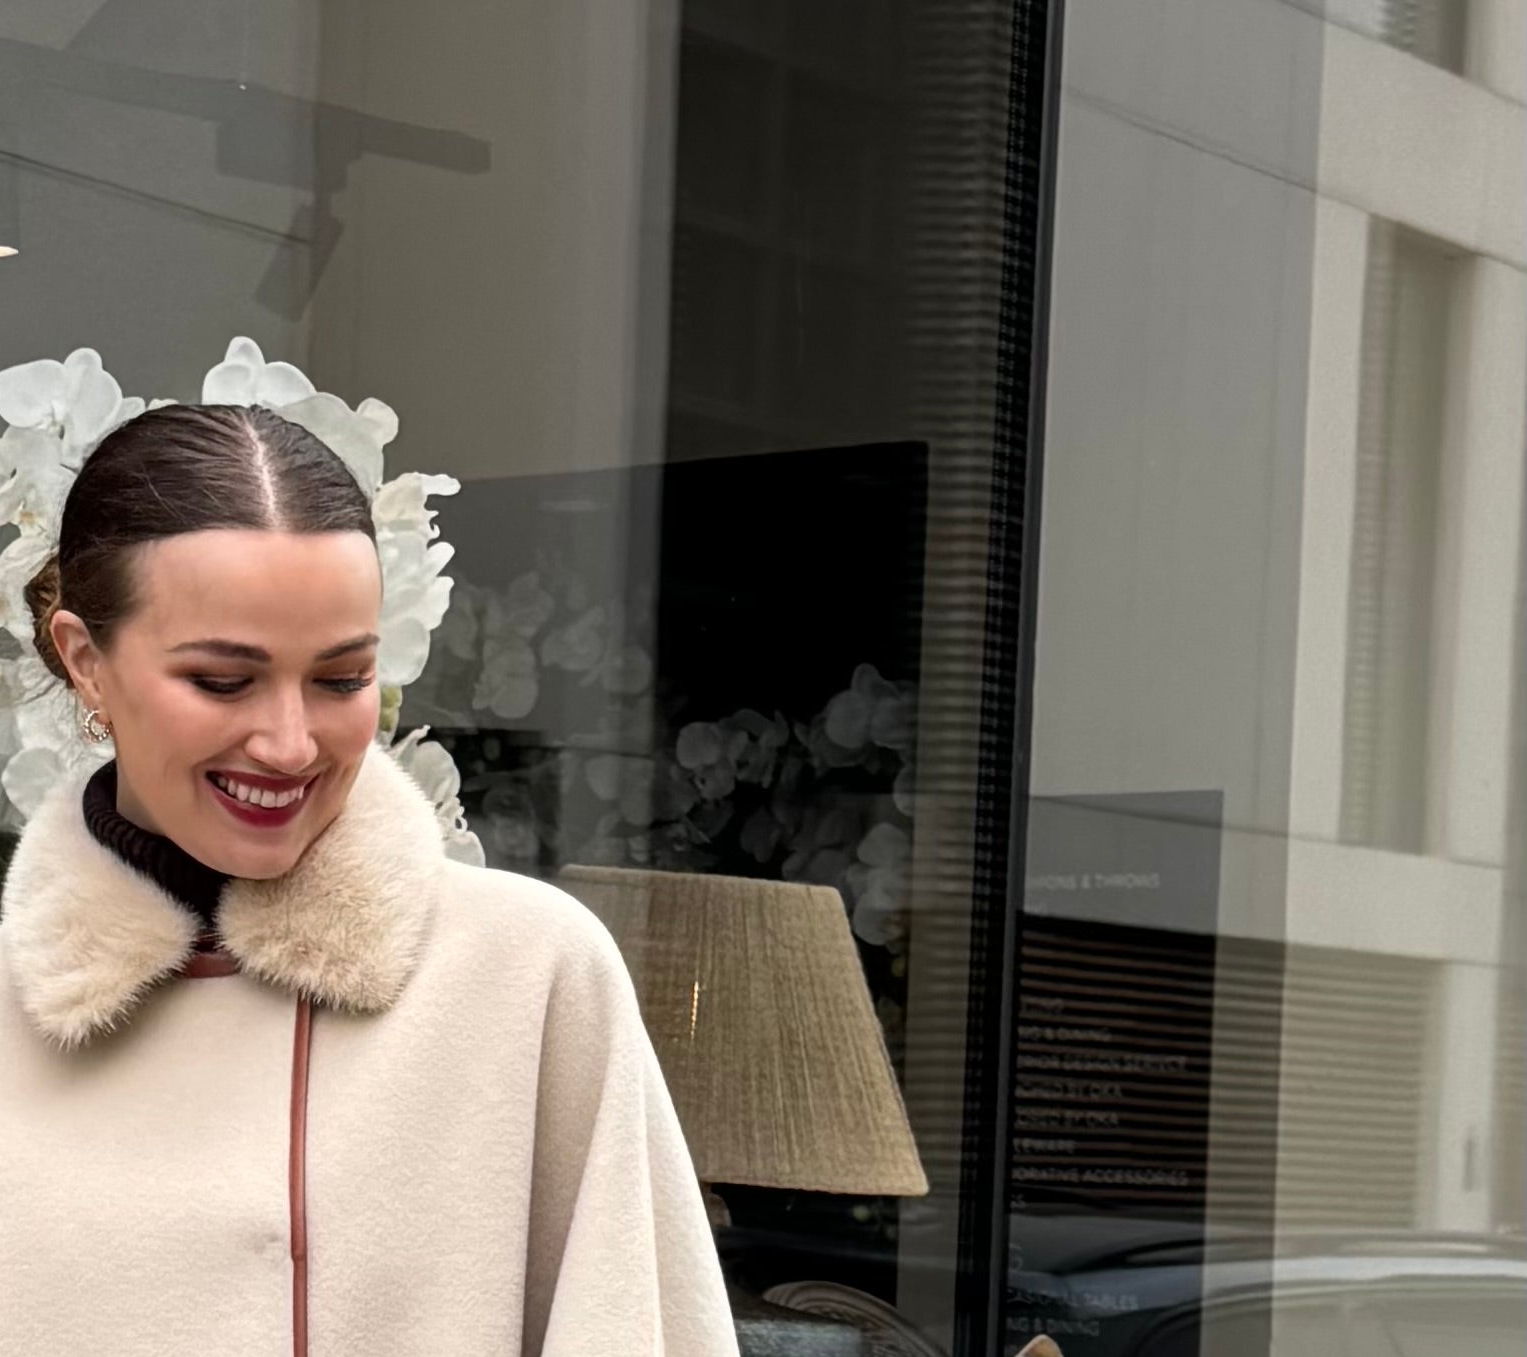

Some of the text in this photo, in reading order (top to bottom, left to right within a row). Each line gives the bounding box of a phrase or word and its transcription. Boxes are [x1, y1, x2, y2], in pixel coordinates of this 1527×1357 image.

[1094, 872, 1160, 889] THROWS
[1086, 1110, 1120, 1127] OKA
[1081, 1168, 1189, 1186] ACCESSORIES
